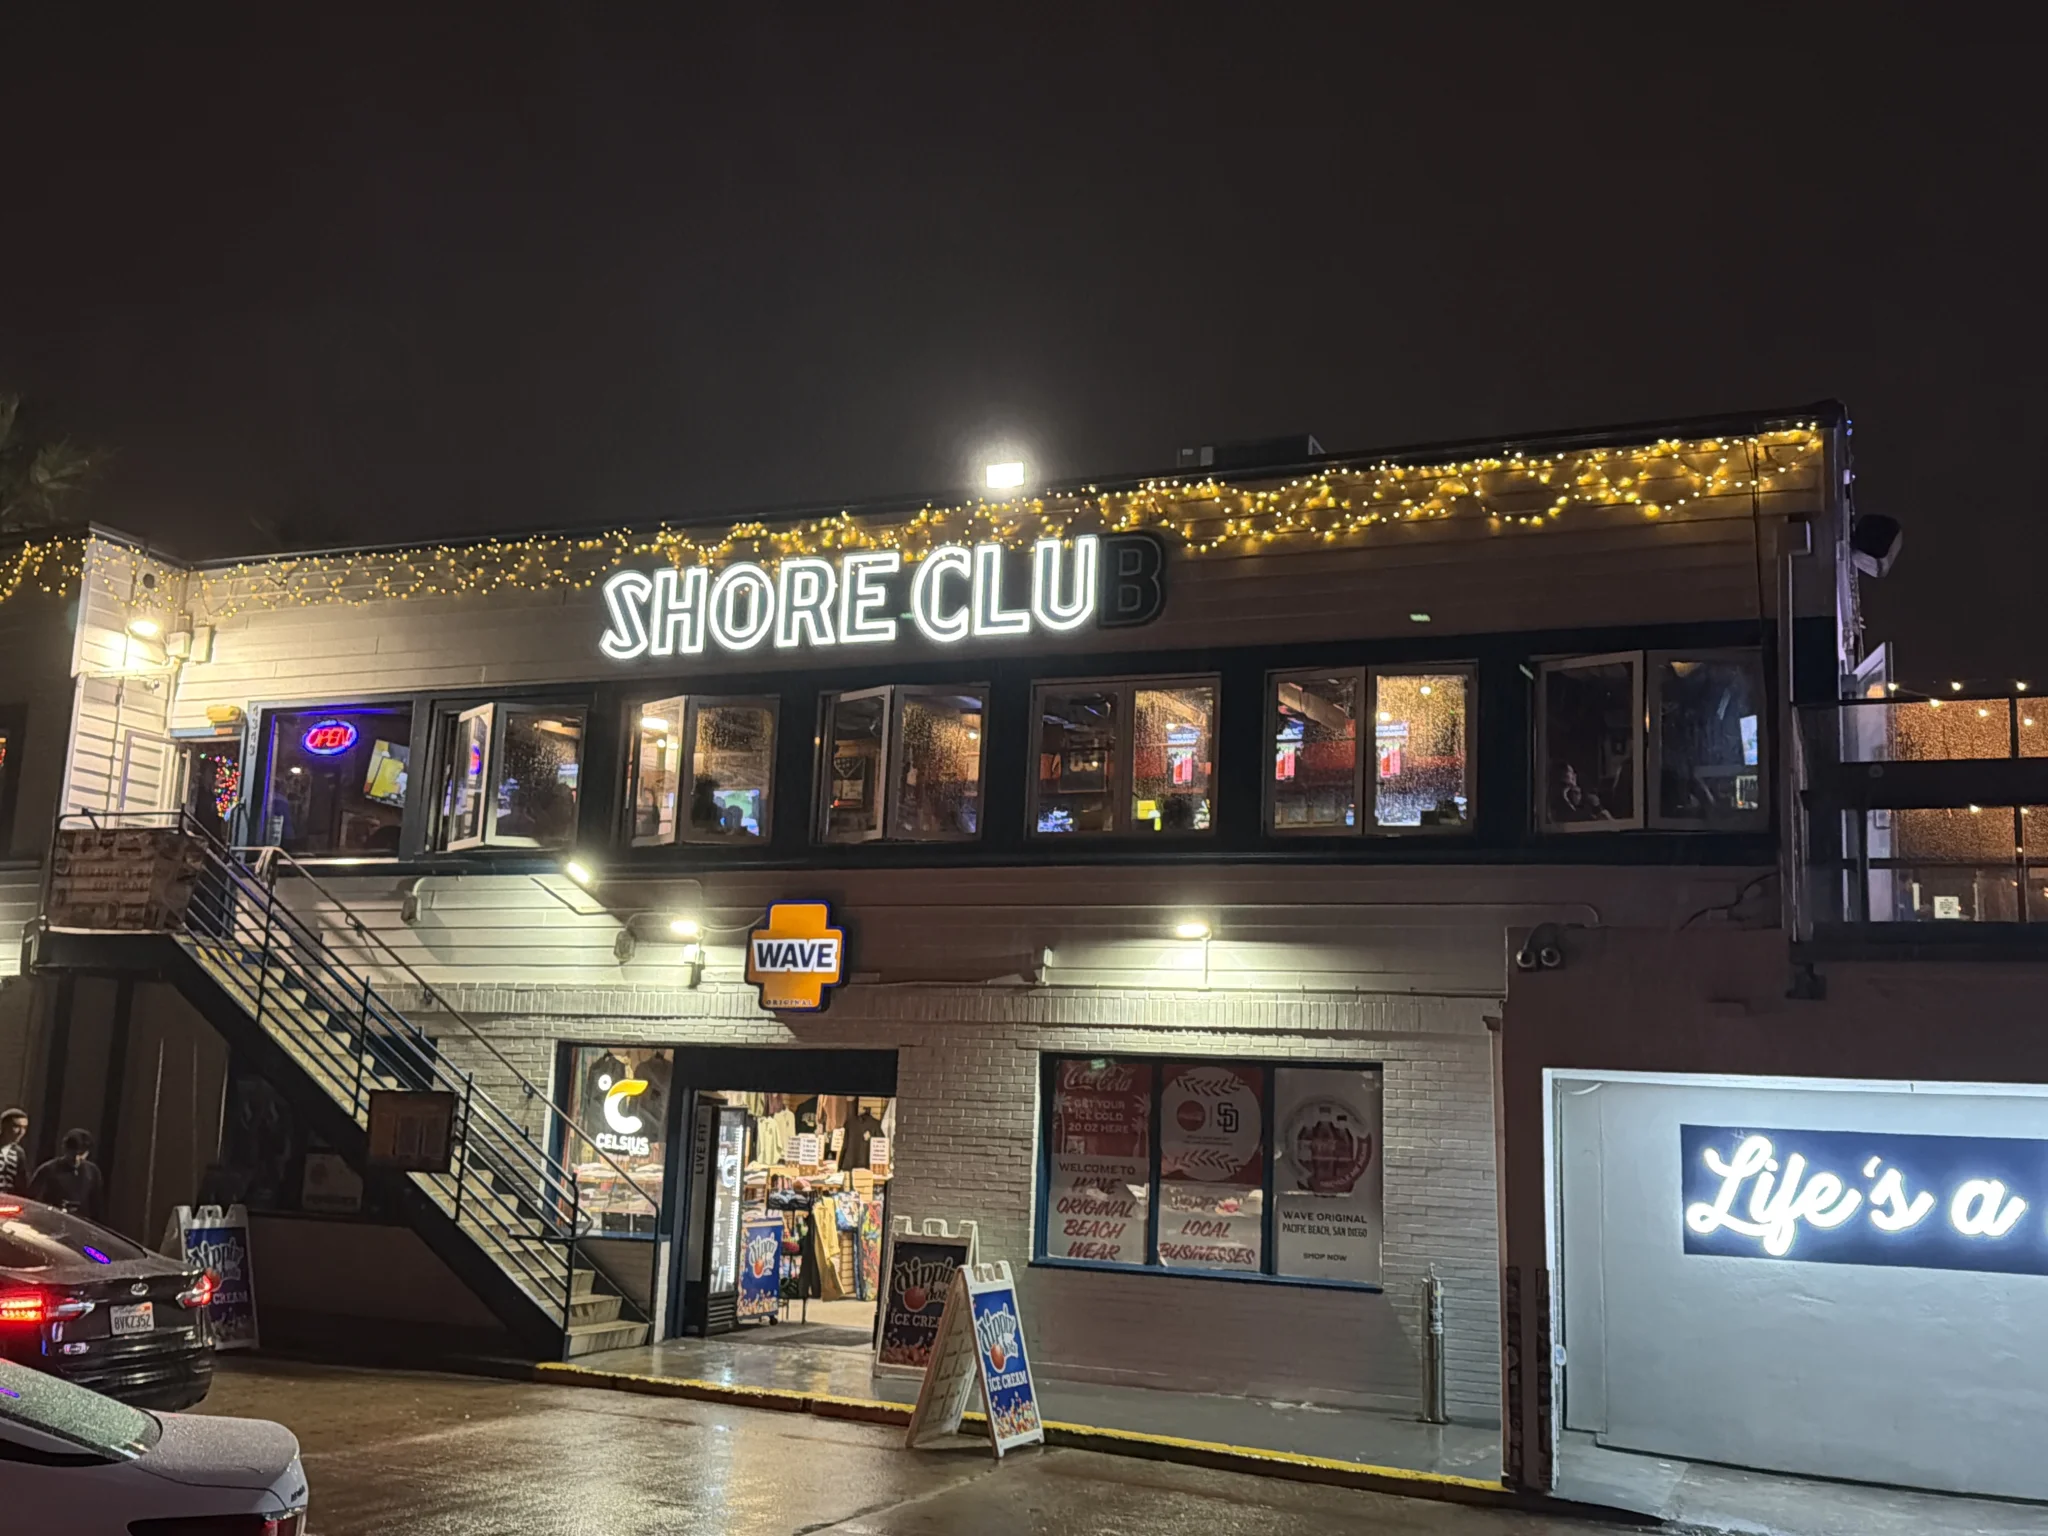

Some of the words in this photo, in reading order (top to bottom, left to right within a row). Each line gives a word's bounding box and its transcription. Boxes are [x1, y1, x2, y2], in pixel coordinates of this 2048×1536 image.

[600, 551, 900, 660] SHORE
[913, 531, 1165, 643] CLUB
[308, 726, 354, 748] OPEN
[756, 942, 833, 968] WAVE
[1074, 1099, 1095, 1109] GET
[1097, 1099, 1126, 1110] YOUR
[1075, 1111, 1093, 1121] ICE
[1095, 1111, 1124, 1122] COLD
[1217, 1102, 1239, 1133] SD
[1068, 1123, 1081, 1132] 20
[1084, 1123, 1099, 1132] OZ
[1101, 1124, 1130, 1134] HERE
[596, 1132, 649, 1155] CELSIUS
[695, 1146, 706, 1175] LIVE
[1058, 1162, 1119, 1175] WELCOME
[1120, 1165, 1136, 1176] TO
[1686, 1135, 1936, 1257] Life's
[1950, 1178, 2029, 1238] a
[1056, 1197, 1134, 1219] ORIGINAL
[1282, 1211, 1314, 1221] WAVE
[1316, 1212, 1368, 1224] ORIGINAL
[1063, 1219, 1126, 1239] BEACH
[1181, 1219, 1232, 1238] LOCAL
[1282, 1223, 1306, 1234] PACIFIC
[1332, 1225, 1346, 1236] SAN
[1347, 1226, 1368, 1238] DIEGO
[1067, 1241, 1121, 1260] WEAR
[1158, 1242, 1255, 1265] BUSINESSES
[1303, 1252, 1326, 1261] SHOP
[1327, 1253, 1347, 1262] NOW
[114, 1313, 152, 1330] 8VKZ352
[912, 1314, 939, 1328] CRE
[1002, 1370, 1028, 1389] CREAM
